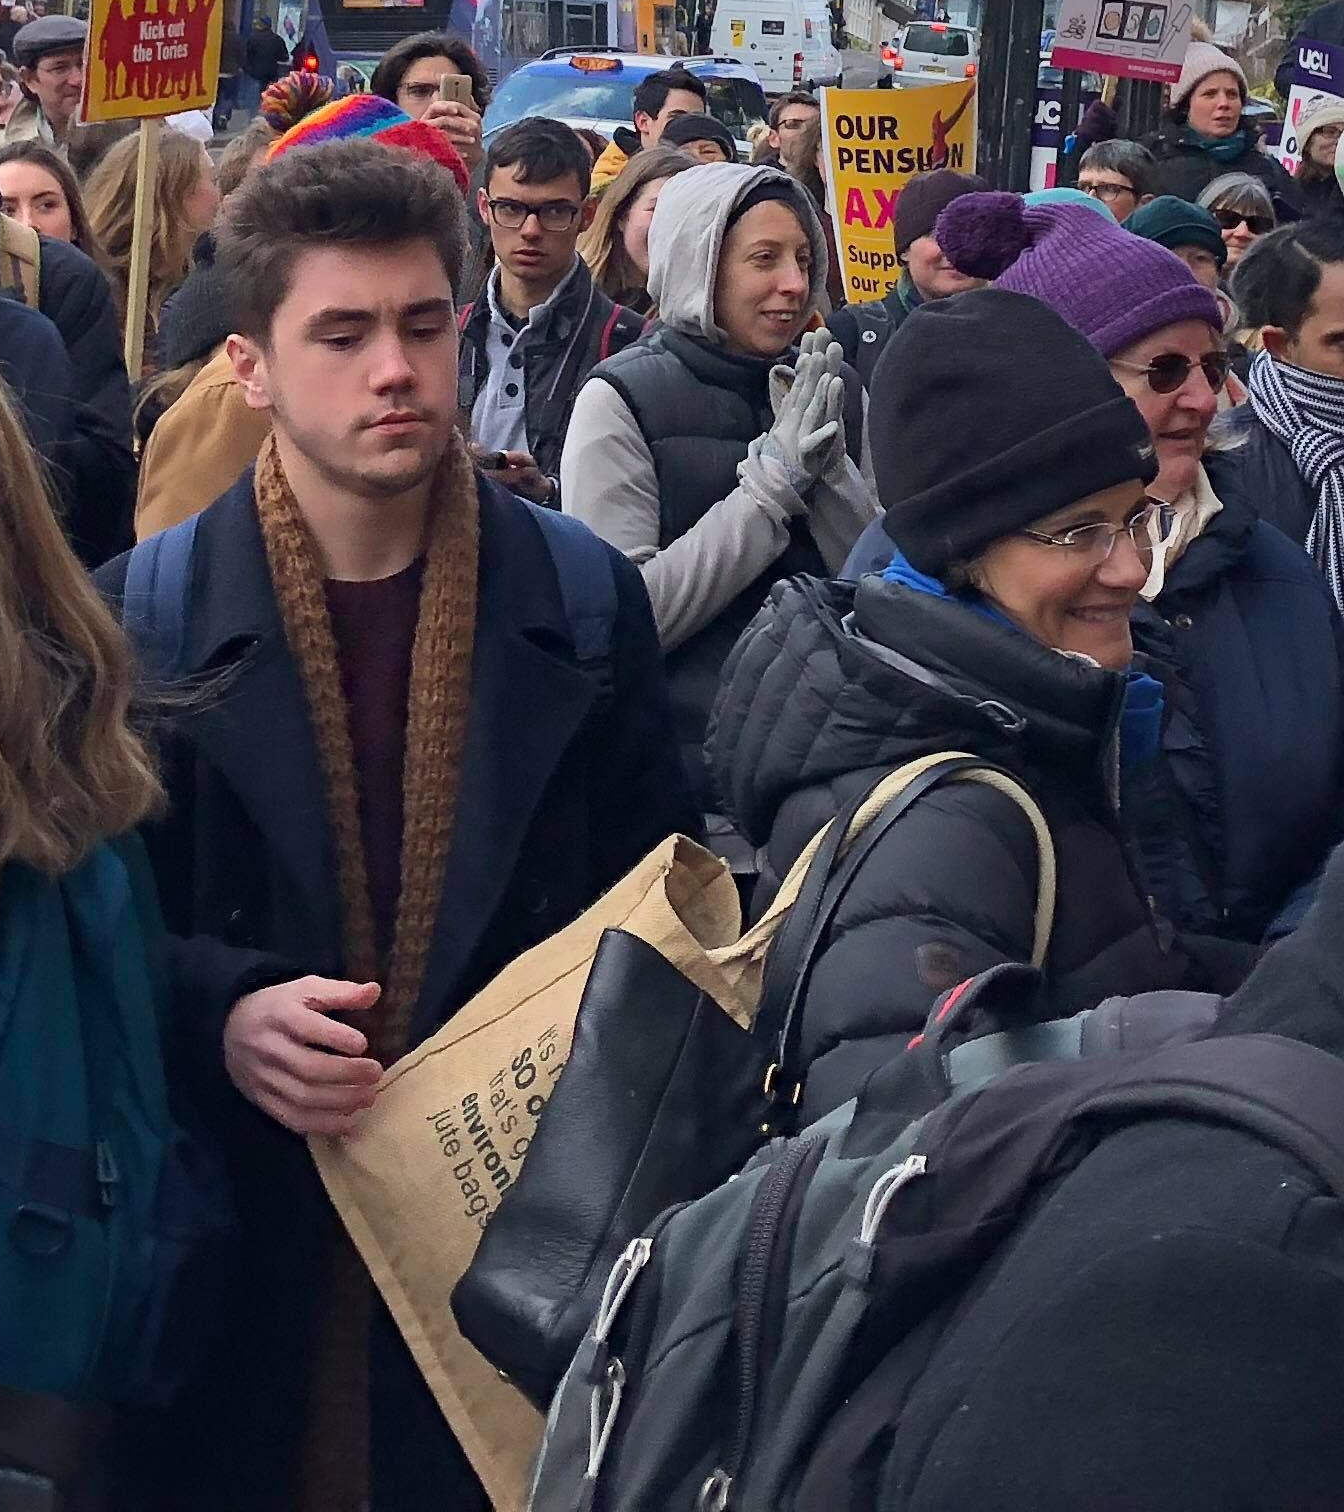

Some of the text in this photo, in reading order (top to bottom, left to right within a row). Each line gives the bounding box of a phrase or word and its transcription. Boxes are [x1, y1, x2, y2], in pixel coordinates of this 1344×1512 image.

[139, 19, 186, 40] Kick out
[133, 41, 188, 63] the Tories
[836, 115, 899, 140] OUR
[838, 143, 964, 173] PENSION
[851, 276, 879, 292] our
[426, 1106, 461, 1158] jute
